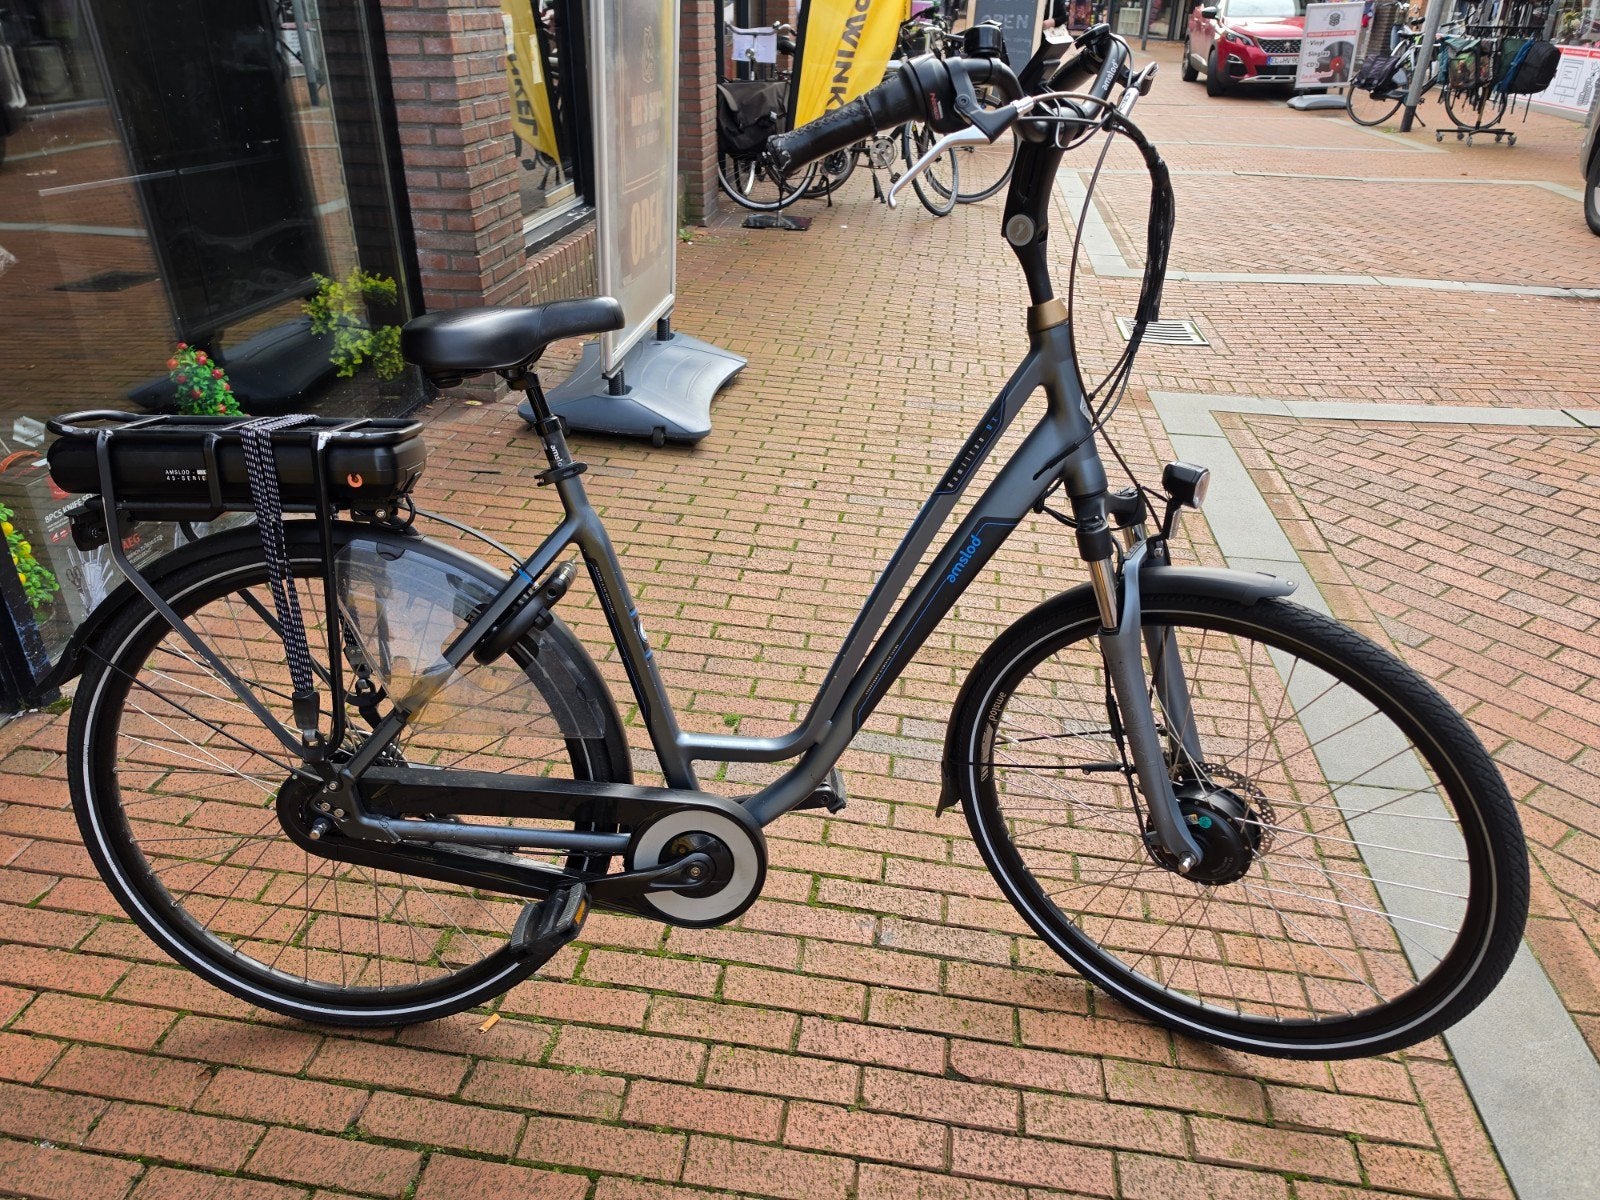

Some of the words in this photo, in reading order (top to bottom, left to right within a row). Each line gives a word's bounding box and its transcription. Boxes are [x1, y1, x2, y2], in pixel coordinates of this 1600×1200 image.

[1102, 60, 1118, 90] amslod
[44, 508, 63, 524] 8PCS
[121, 533, 141, 551] AEG
[947, 534, 981, 583] amslod
